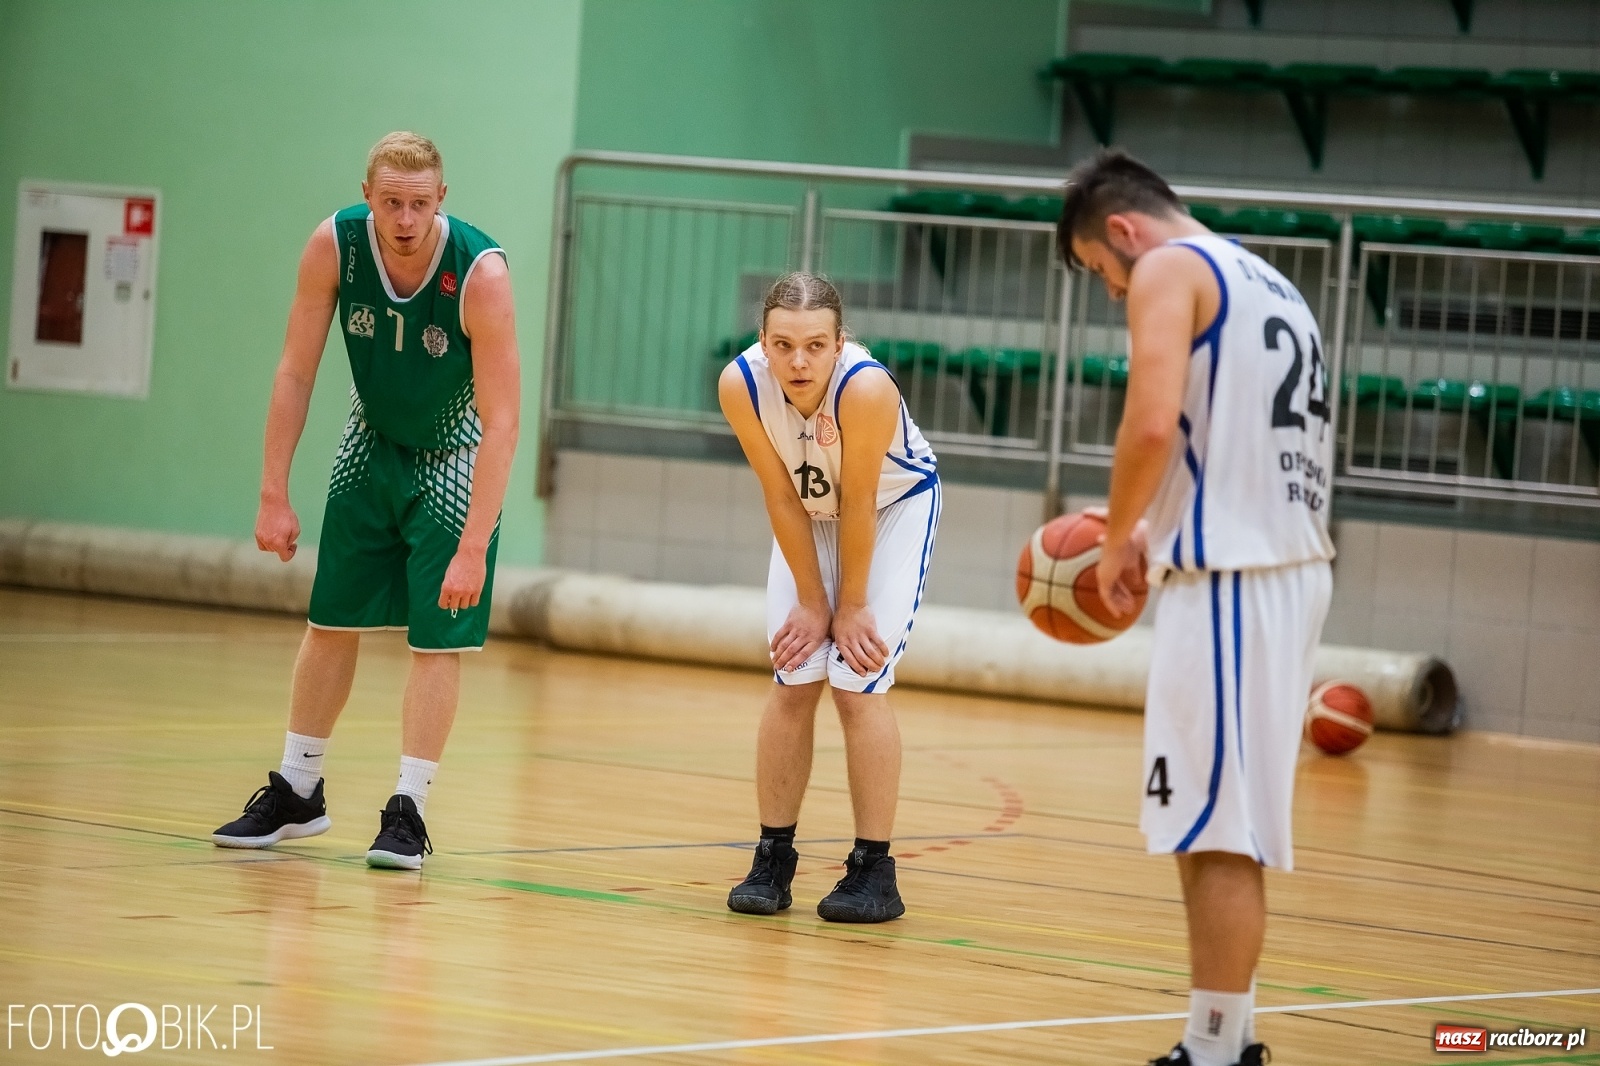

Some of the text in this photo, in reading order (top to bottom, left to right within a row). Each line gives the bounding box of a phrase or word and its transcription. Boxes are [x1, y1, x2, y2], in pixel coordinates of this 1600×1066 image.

[386, 307, 405, 352] 7
[1264, 316, 1331, 442] 24
[794, 460, 831, 499] 13
[1147, 756, 1173, 807] 4
